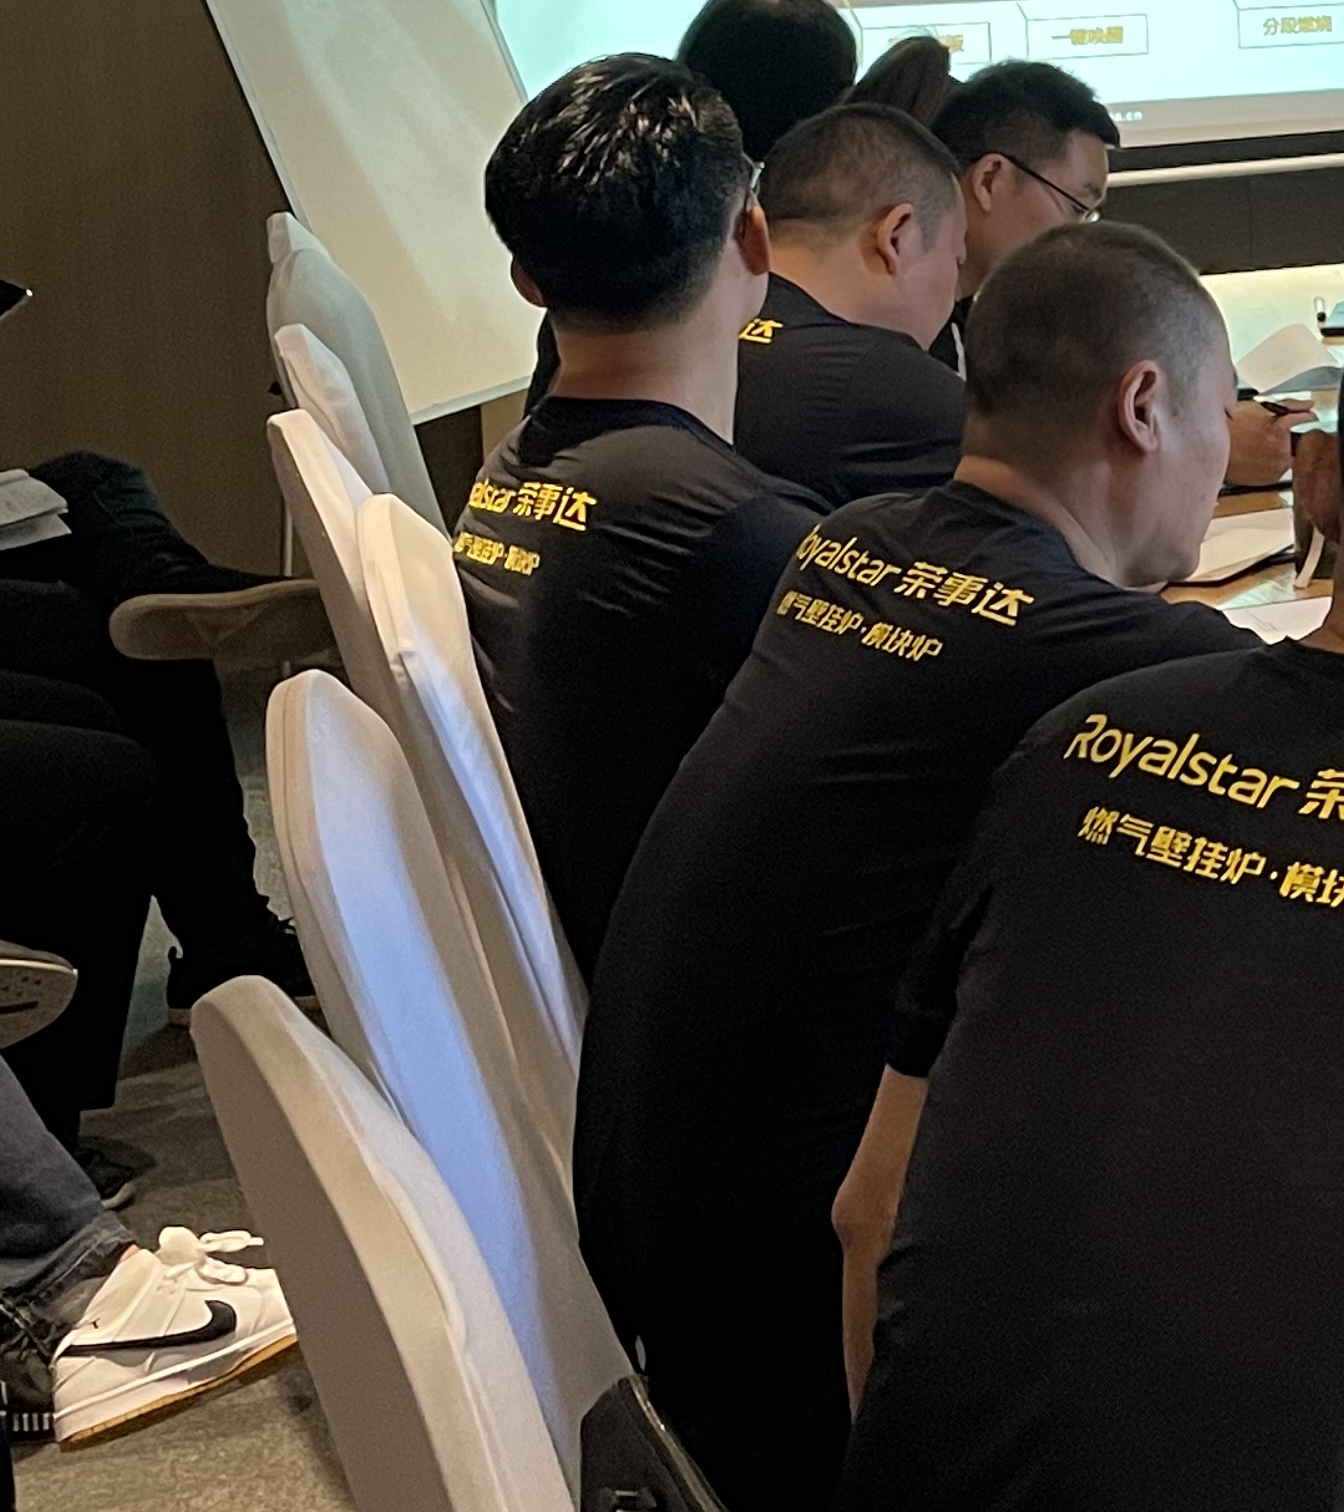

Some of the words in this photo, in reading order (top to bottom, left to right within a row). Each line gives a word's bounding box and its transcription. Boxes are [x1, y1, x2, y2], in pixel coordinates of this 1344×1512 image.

[512, 481, 598, 532] 荣事达
[796, 523, 902, 587] oyalstar
[893, 560, 1036, 627] 荣事达
[1063, 713, 1300, 810] Royalstar
